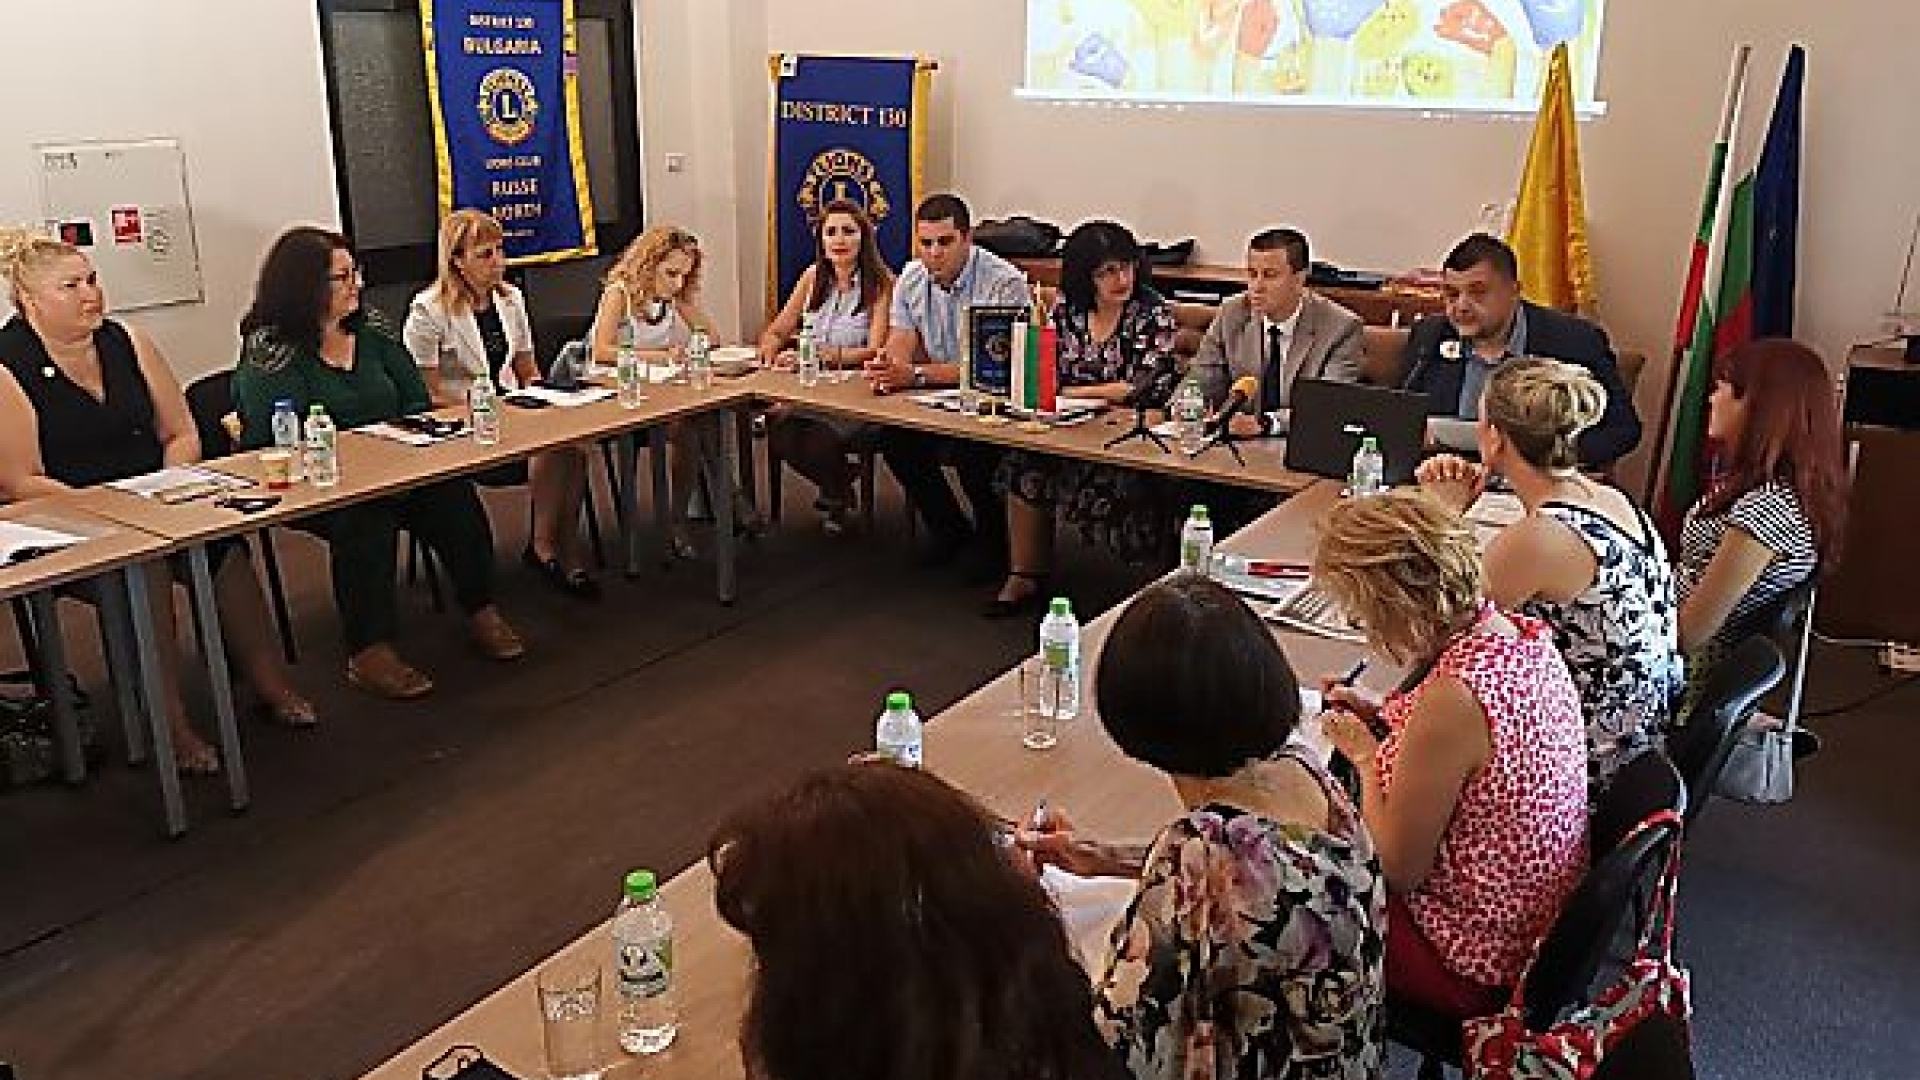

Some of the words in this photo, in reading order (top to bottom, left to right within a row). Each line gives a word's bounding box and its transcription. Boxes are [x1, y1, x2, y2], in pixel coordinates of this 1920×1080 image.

[464, 37, 542, 54] BULGARIA
[502, 95, 517, 118] L
[781, 101, 873, 126] DISTRICT
[879, 108, 907, 128] 130
[492, 178, 538, 197] RUSSE
